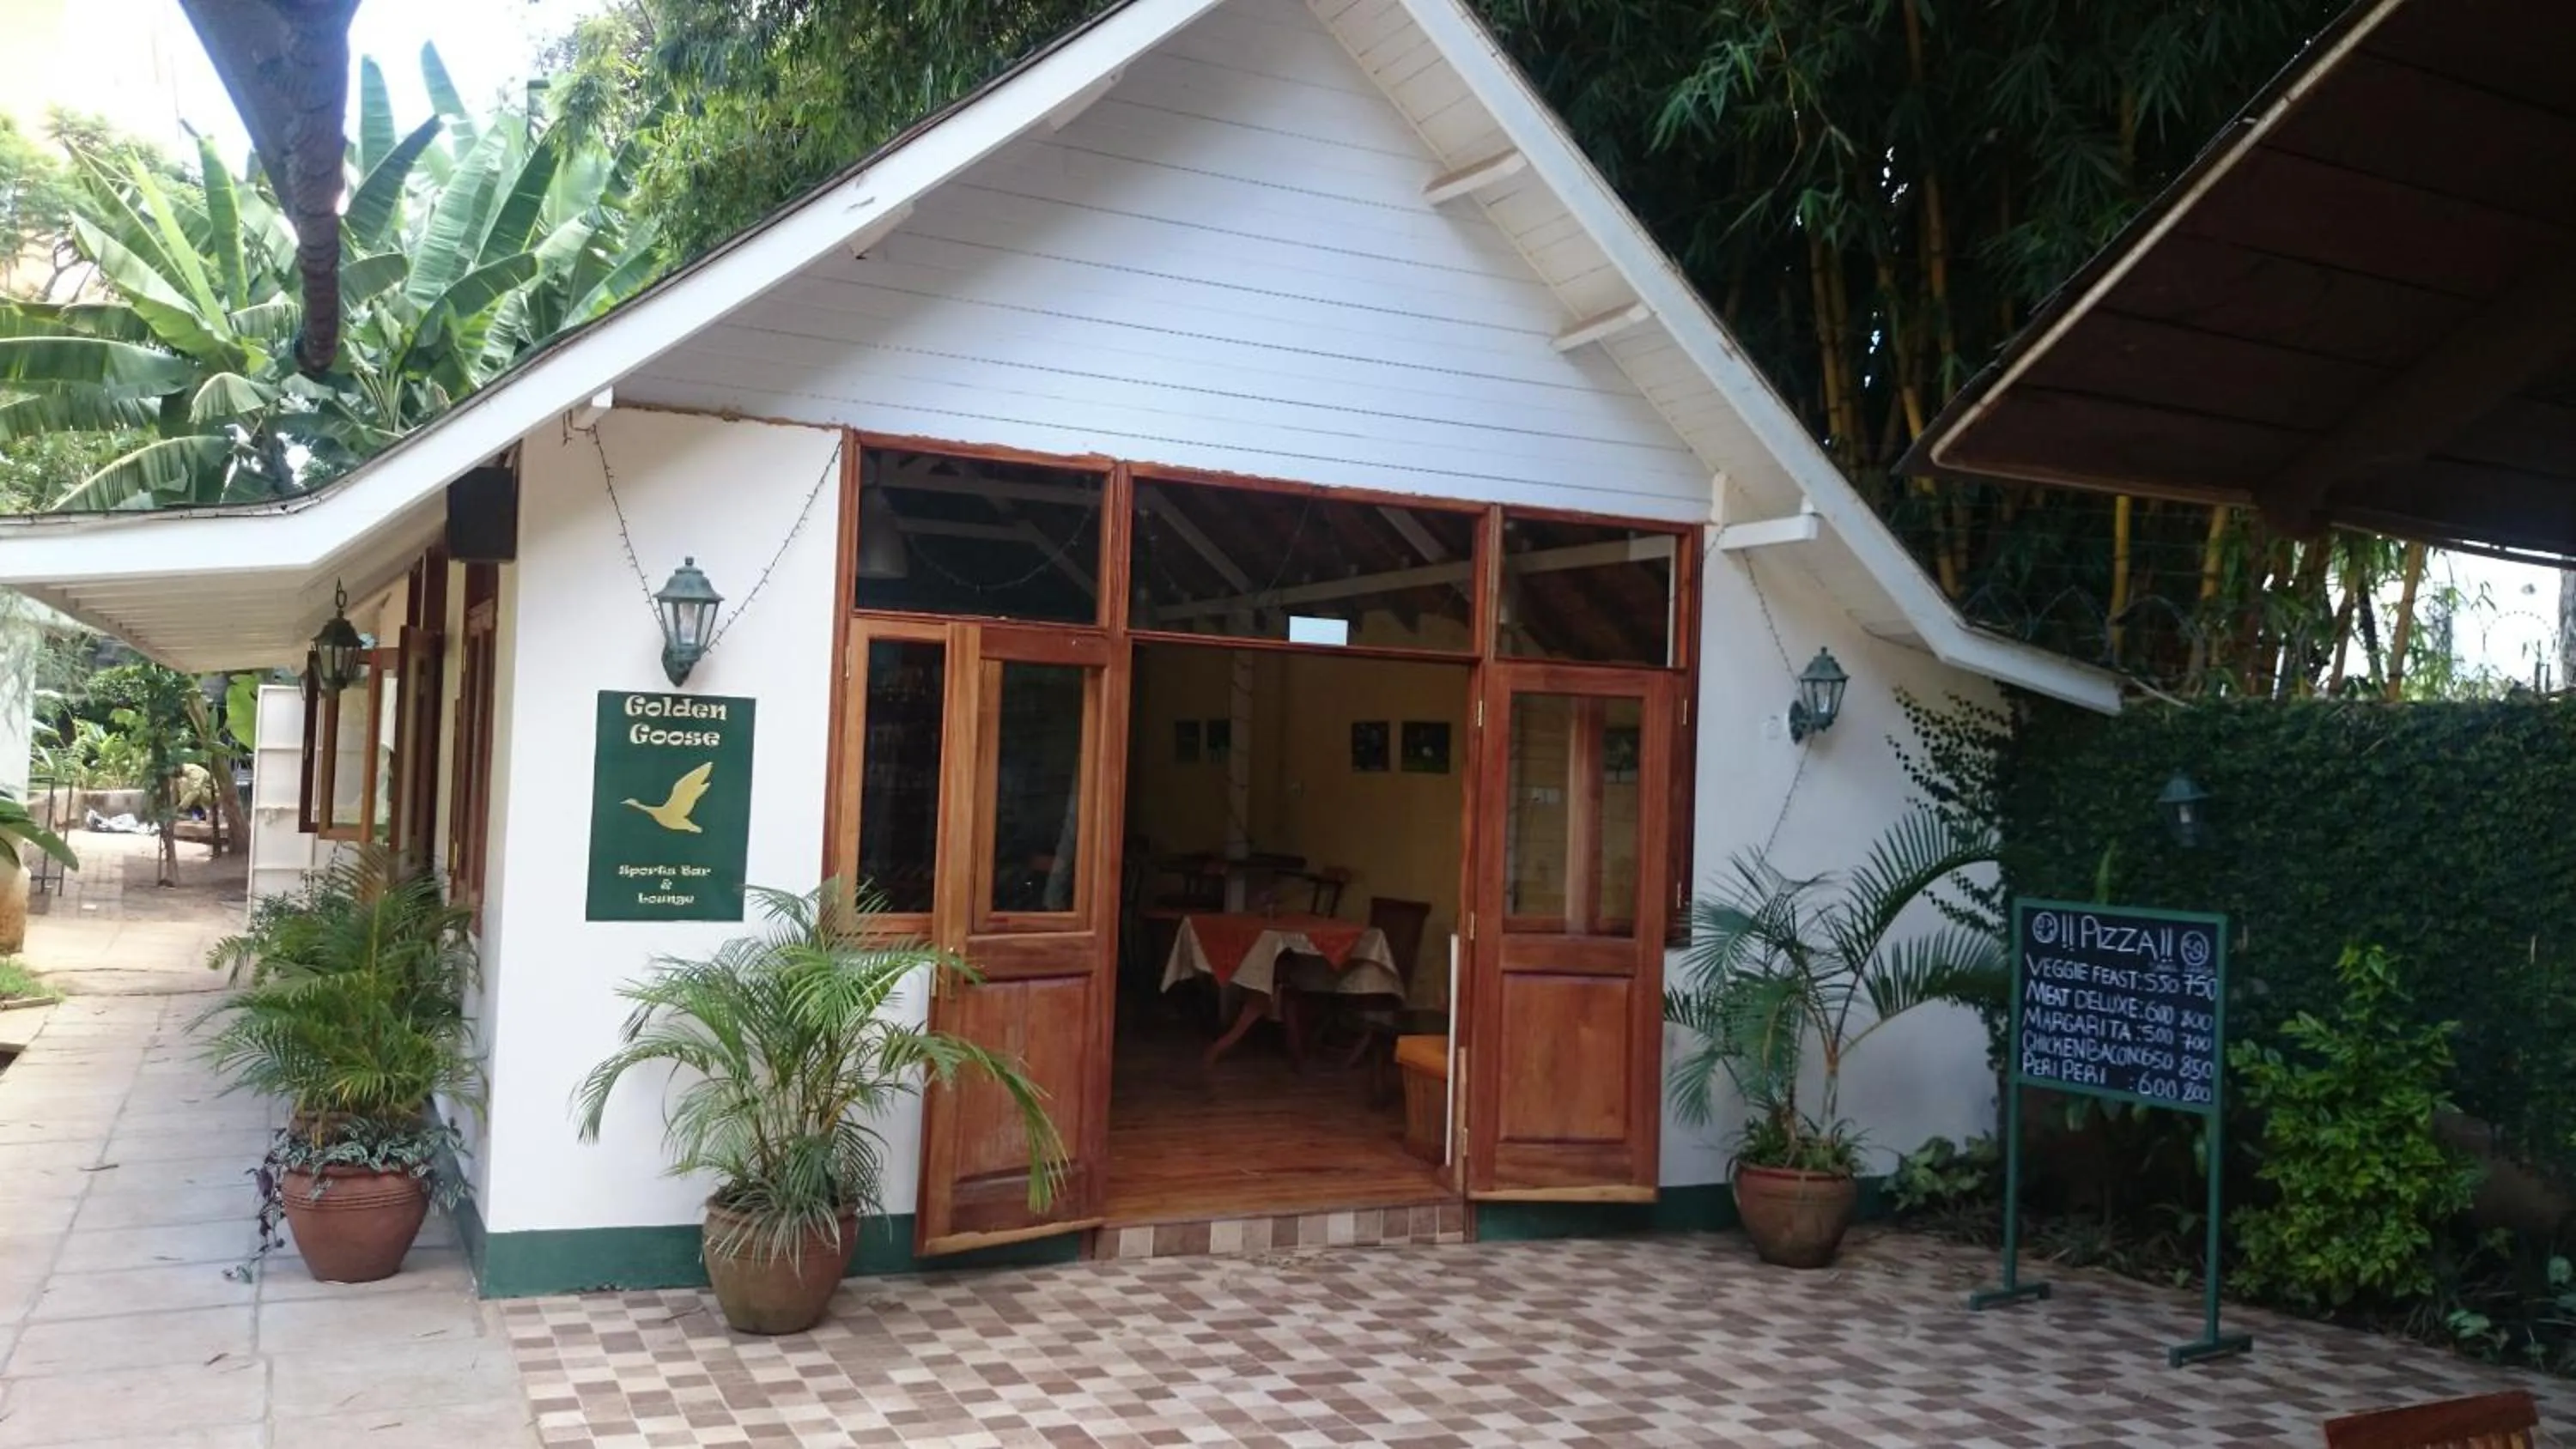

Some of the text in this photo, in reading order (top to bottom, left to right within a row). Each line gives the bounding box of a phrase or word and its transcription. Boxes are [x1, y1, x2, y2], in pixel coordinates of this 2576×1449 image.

[624, 694, 727, 721] Golden
[629, 722, 720, 747] Goose
[618, 864, 712, 877] Sports Bar
[660, 878, 672, 890] &
[638, 893, 695, 906] Lounge
[2026, 953, 2089, 980] VEGGIE
[2182, 973, 2218, 1002] 750
[2026, 979, 2071, 1008] MEAT
[2022, 1006, 2131, 1041] MARGARITA
[2179, 1032, 2213, 1052] 700
[2022, 1051, 2057, 1076] PERI
[2063, 1058, 2106, 1083] PERI
[2178, 1055, 2214, 1080] 850
